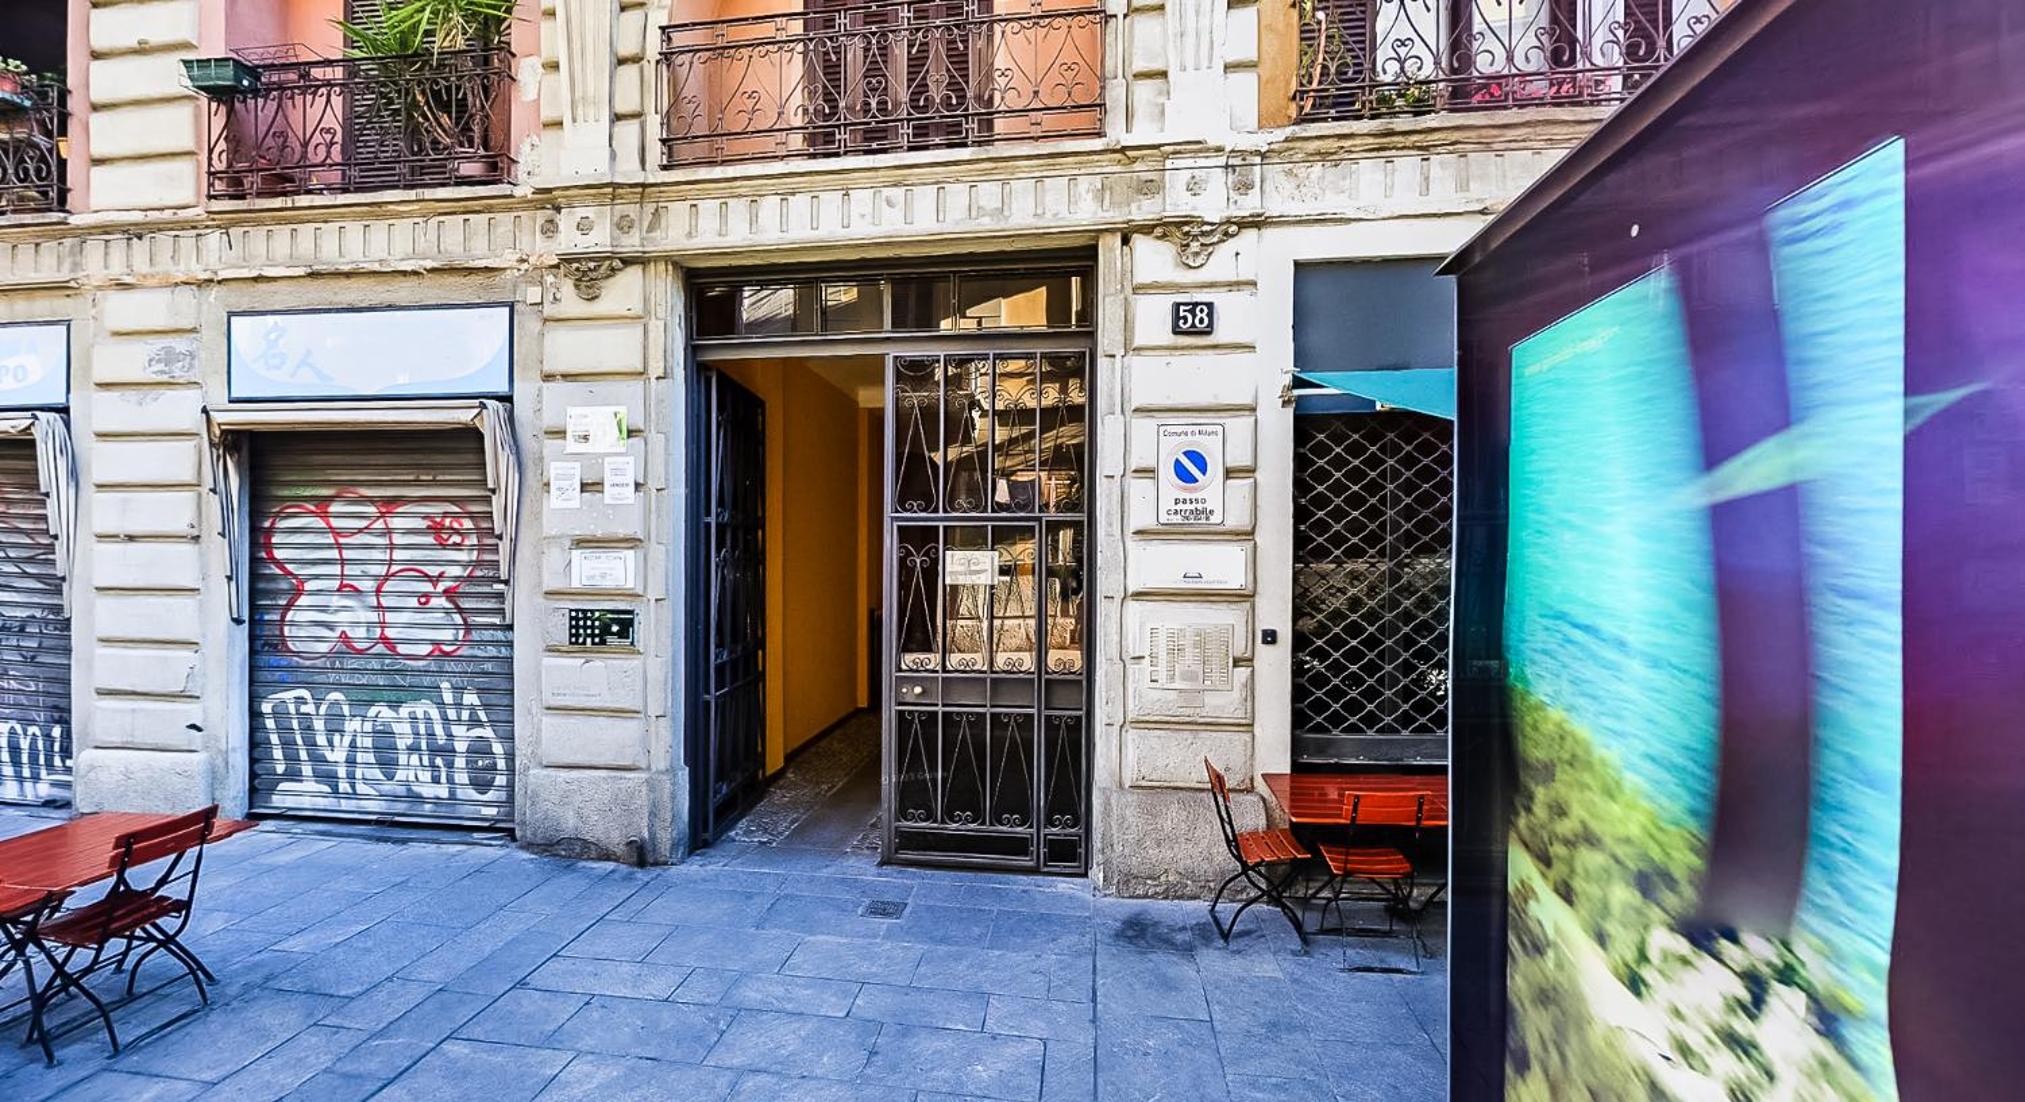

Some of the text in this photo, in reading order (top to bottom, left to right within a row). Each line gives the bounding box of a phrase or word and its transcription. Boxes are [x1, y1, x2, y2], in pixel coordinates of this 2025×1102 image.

[1178, 304, 1209, 329] 58
[1174, 497, 1207, 506] passo
[1166, 507, 1215, 516] carrabile
